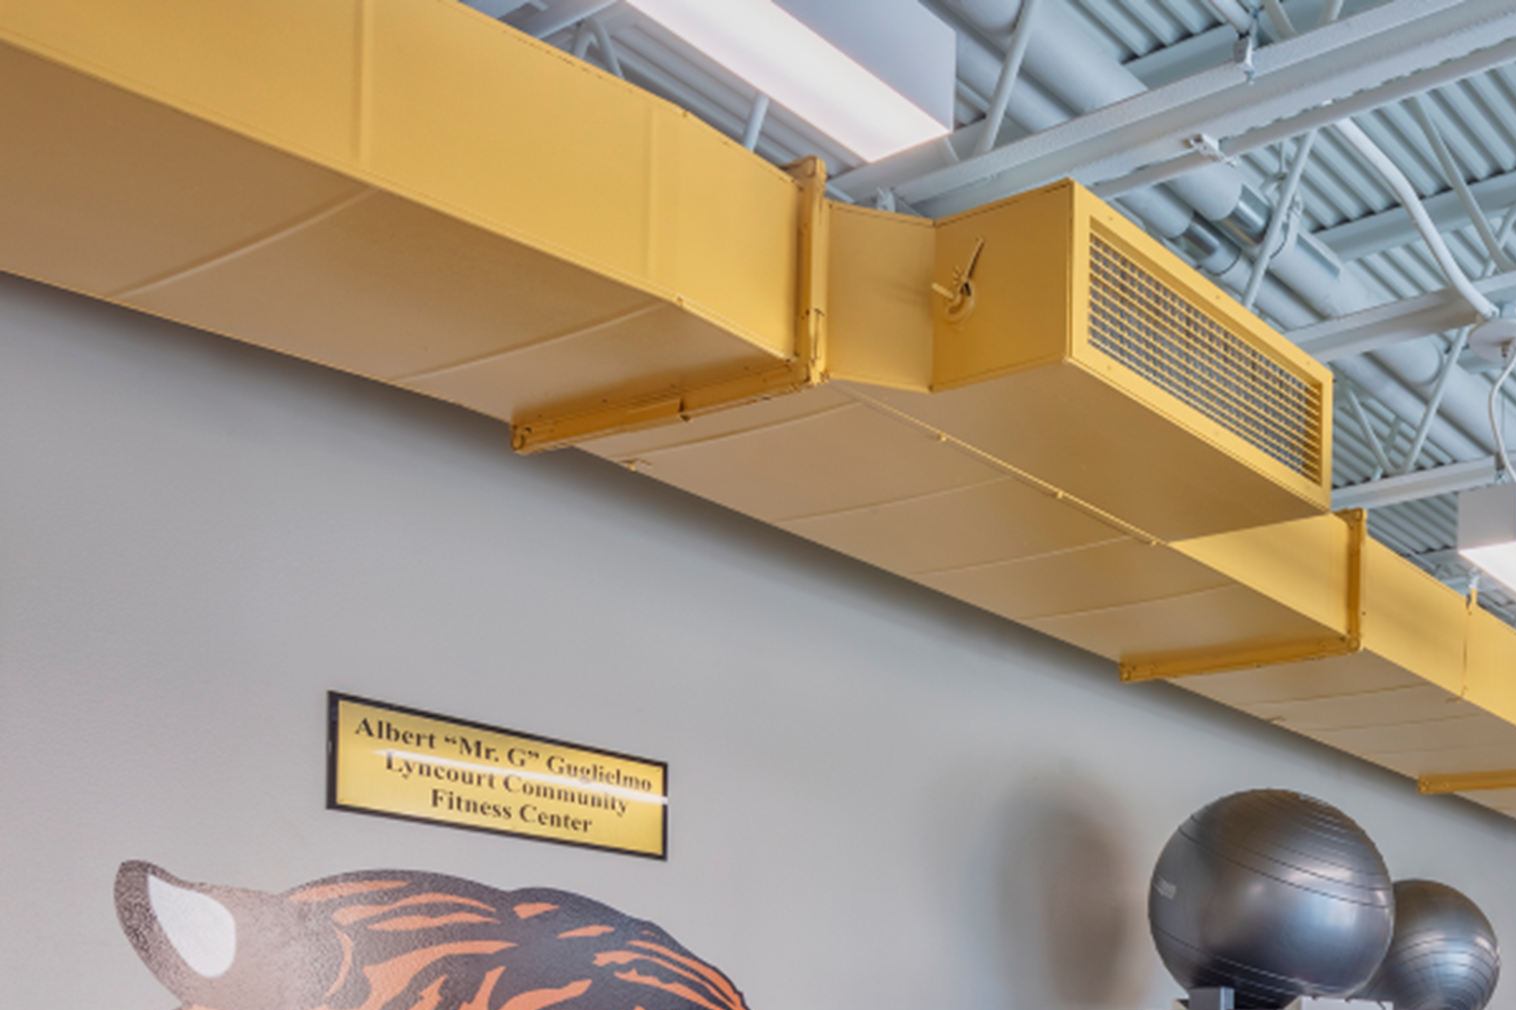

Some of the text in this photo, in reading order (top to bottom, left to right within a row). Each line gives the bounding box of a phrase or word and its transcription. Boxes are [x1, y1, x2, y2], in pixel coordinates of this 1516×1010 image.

[354, 716, 437, 749] Albert
[545, 755, 653, 792] Guglielmo
[385, 751, 630, 817] Lyncourt Community
[430, 788, 593, 833] Fitness Center
